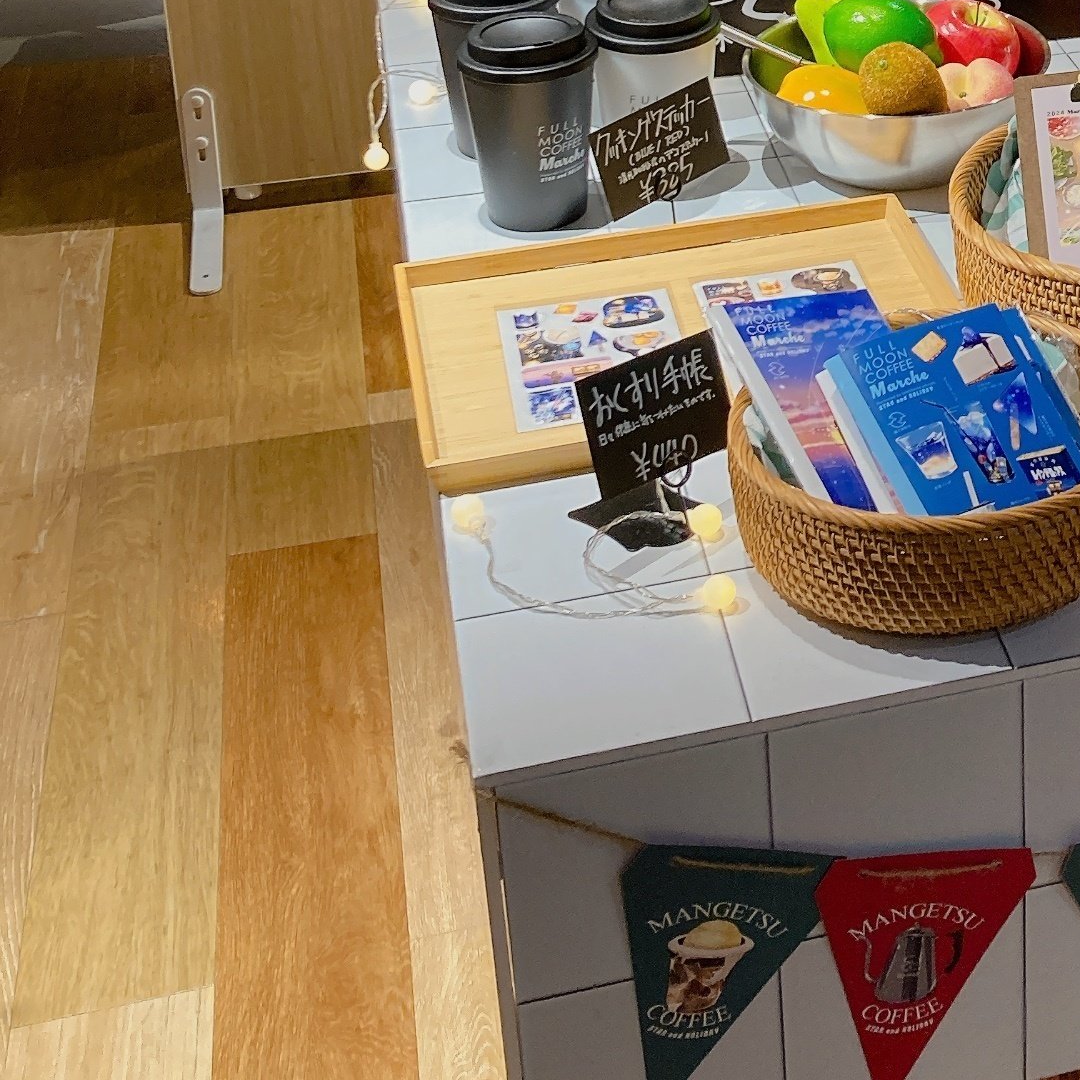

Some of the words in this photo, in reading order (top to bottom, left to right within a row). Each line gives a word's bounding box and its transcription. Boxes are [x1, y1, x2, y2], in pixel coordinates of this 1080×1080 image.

[537, 116, 578, 137] FULL
[537, 126, 583, 148] MOON
[539, 138, 583, 159] COFFEE
[746, 321, 791, 336] COFFEE
[852, 340, 897, 363] FULL
[858, 347, 908, 375] MOON
[865, 357, 914, 384] COFFEE
[588, 347, 714, 429] おくすり手帳
[868, 369, 930, 400] Marche
[646, 900, 789, 939] MANGETSU
[846, 901, 986, 943] MANGETSU
[645, 1003, 732, 1030] COFFEE
[860, 996, 945, 1026] COFFEE
